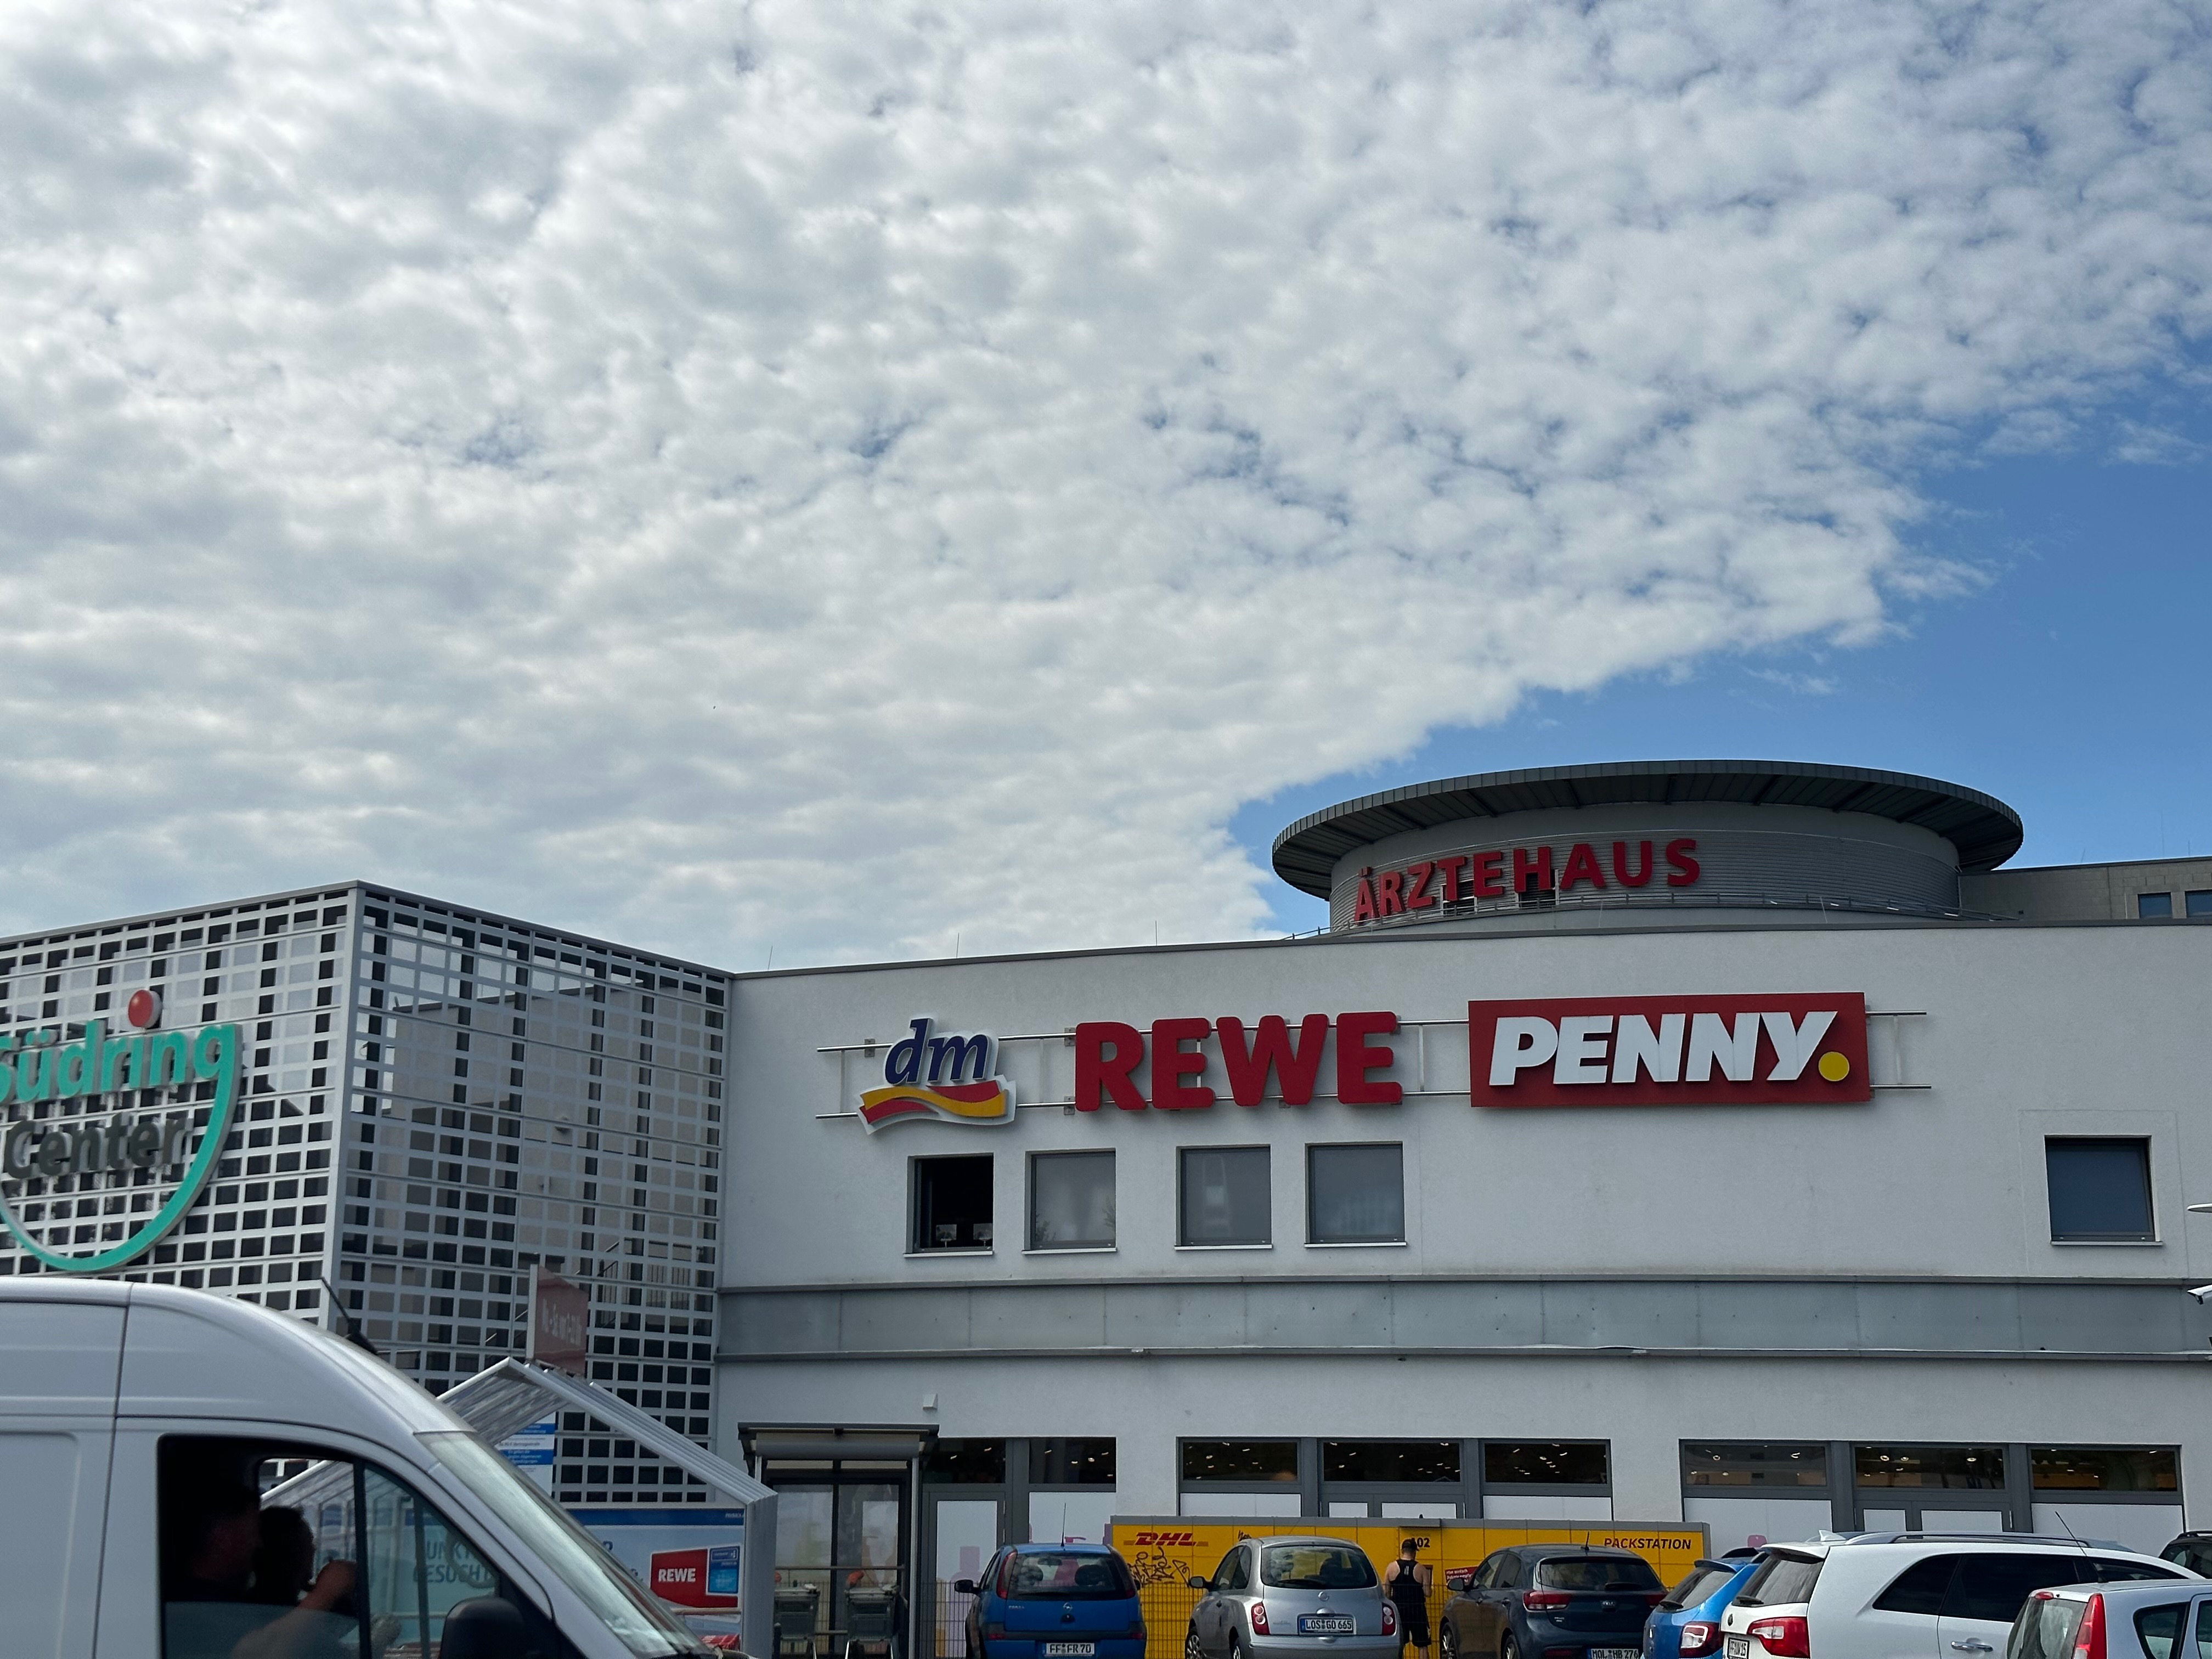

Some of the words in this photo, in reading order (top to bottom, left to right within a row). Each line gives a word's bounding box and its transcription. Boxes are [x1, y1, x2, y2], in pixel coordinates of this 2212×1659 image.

[1353, 838, 1701, 924] ÄRZTEHAUS
[884, 1018, 993, 1084] dm
[1075, 1011, 1404, 1112] REWE
[4, 1112, 192, 1180] Center
[1135, 1532, 1197, 1545] DHL
[1412, 1537, 1430, 1548] 02
[1604, 1538, 1691, 1549] PACKSTATION
[658, 1568, 696, 1582] REWE
[1306, 1620, 1321, 1629] LOS
[1326, 1620, 1336, 1629] GO
[1338, 1620, 1352, 1629] 665
[1049, 1644, 1061, 1654] FF
[1067, 1644, 1079, 1654] FR
[1080, 1644, 1092, 1654] 70
[1592, 1649, 1607, 1659] MOL
[1624, 1649, 1639, 1659] 276
